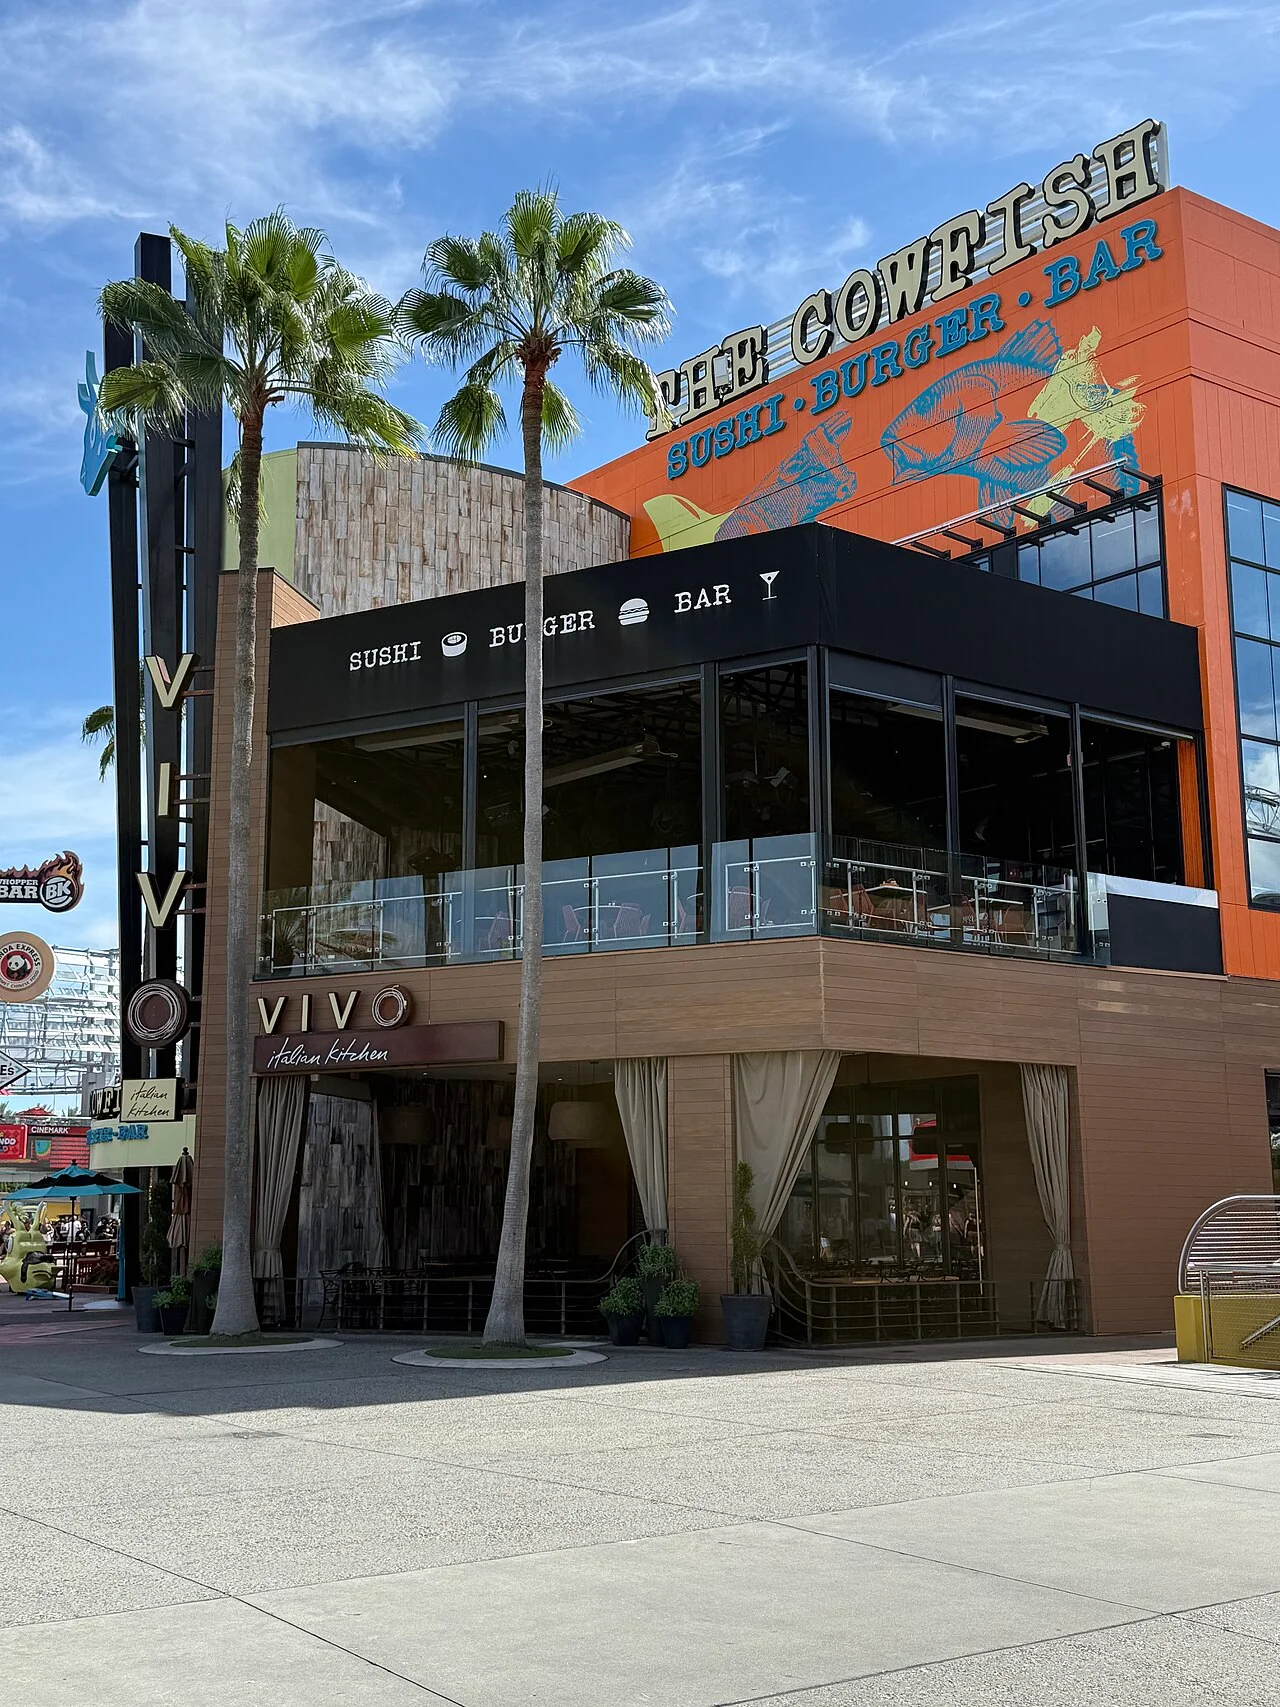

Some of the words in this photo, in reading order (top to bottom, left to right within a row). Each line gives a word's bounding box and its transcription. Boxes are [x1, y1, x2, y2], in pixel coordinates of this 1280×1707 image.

[646, 324, 769, 441] THE
[791, 118, 1164, 364] COWFISH
[666, 393, 787, 480] SUSHI
[810, 293, 1006, 416] BURGER
[1043, 218, 1164, 309] BAR
[349, 640, 422, 671] SUSHI
[488, 610, 596, 648] BUGER
[673, 584, 732, 613] BAR
[0, 885, 39, 899] BAR
[45, 879, 71, 900] BK
[16, 943, 41, 967] EXPRESS
[257, 984, 410, 1035] VIVO
[267, 1037, 321, 1069] italian
[324, 1038, 388, 1065] kitchen
[130, 1081, 168, 1101] italian
[126, 1101, 170, 1118] kitchen
[31, 1126, 69, 1134] CINEMARK
